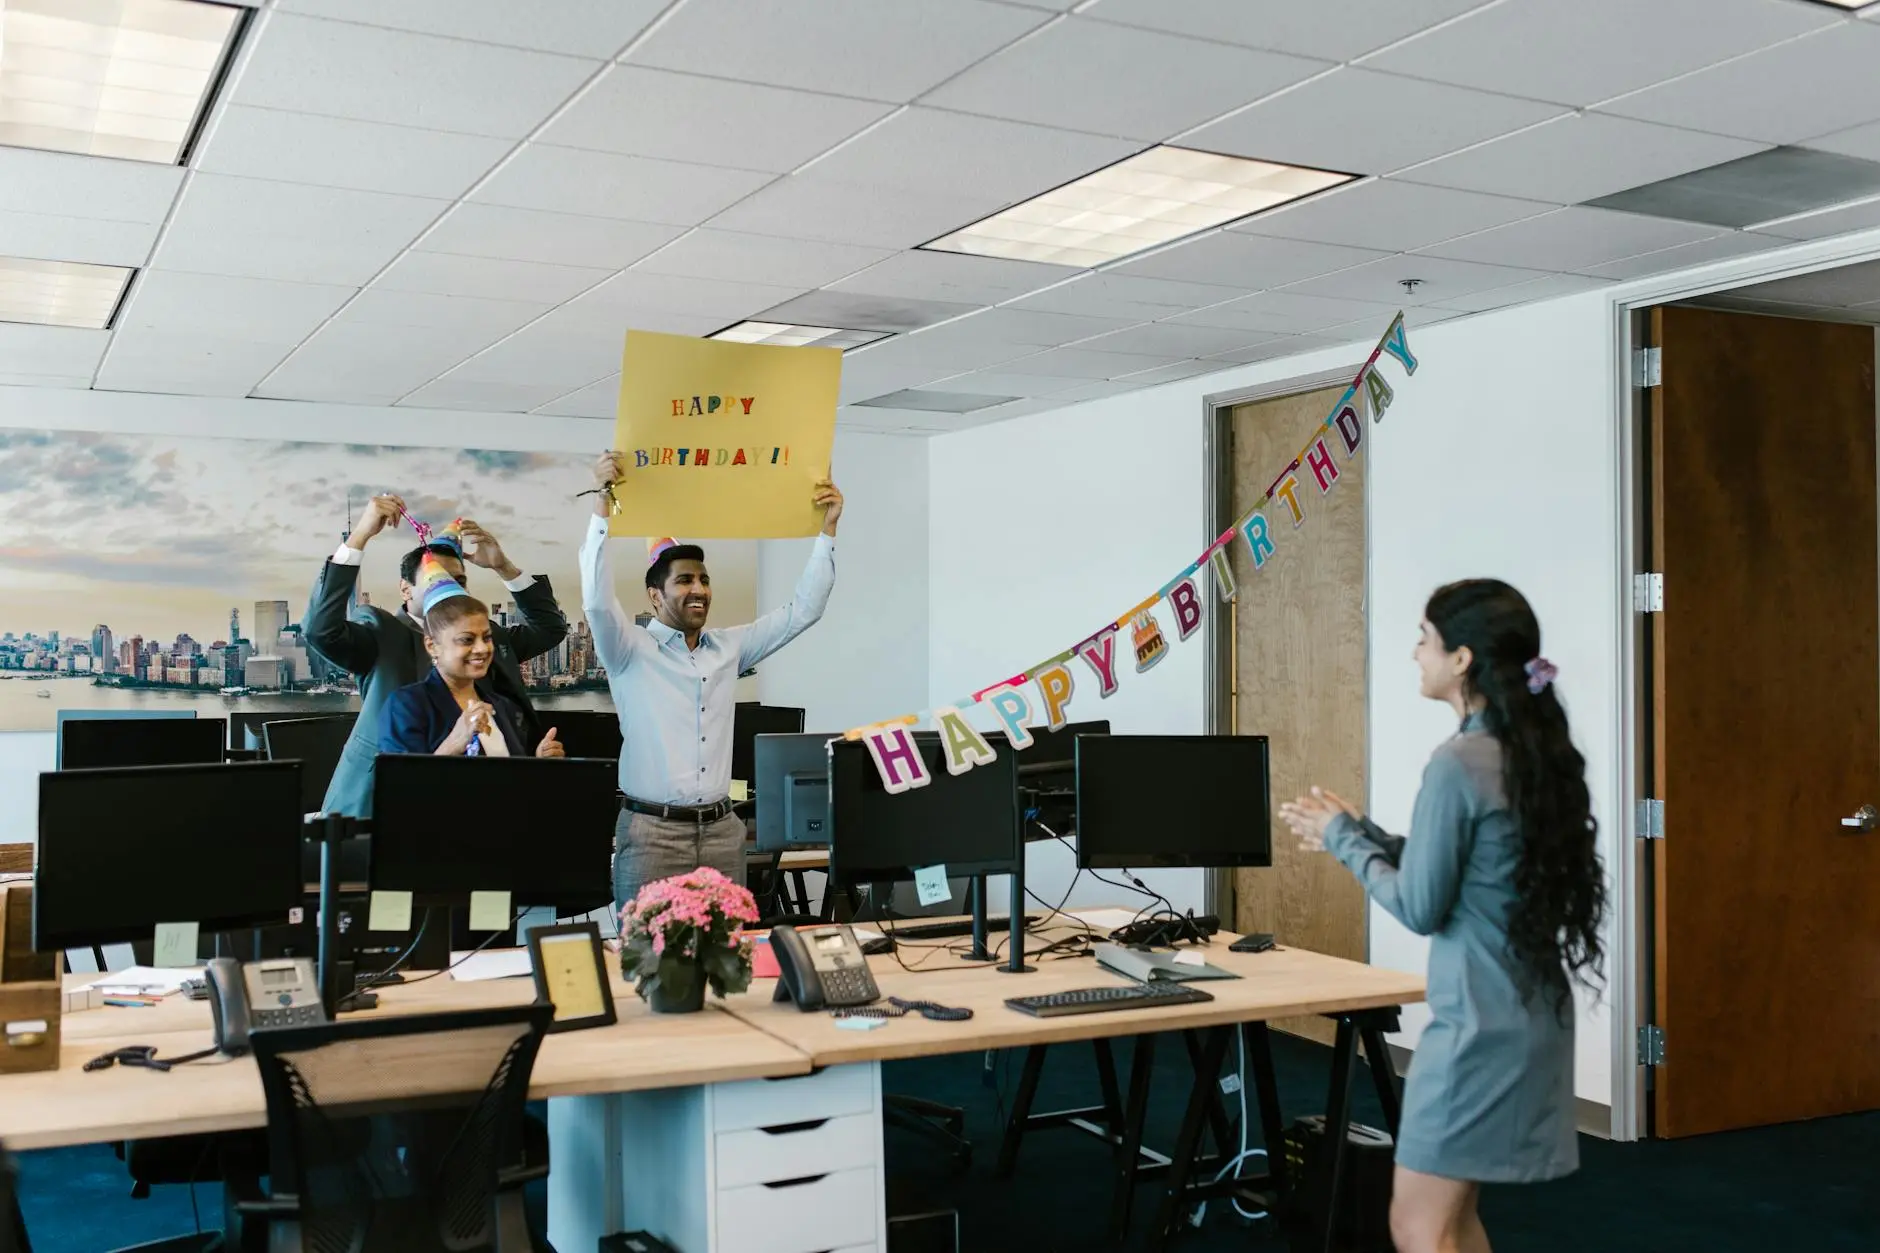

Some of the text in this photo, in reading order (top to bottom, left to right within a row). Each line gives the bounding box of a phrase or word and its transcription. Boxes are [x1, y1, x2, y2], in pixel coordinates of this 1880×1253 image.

[671, 395, 755, 417] HAPPY
[866, 320, 1417, 793] HAPPY BIRTHDAY
